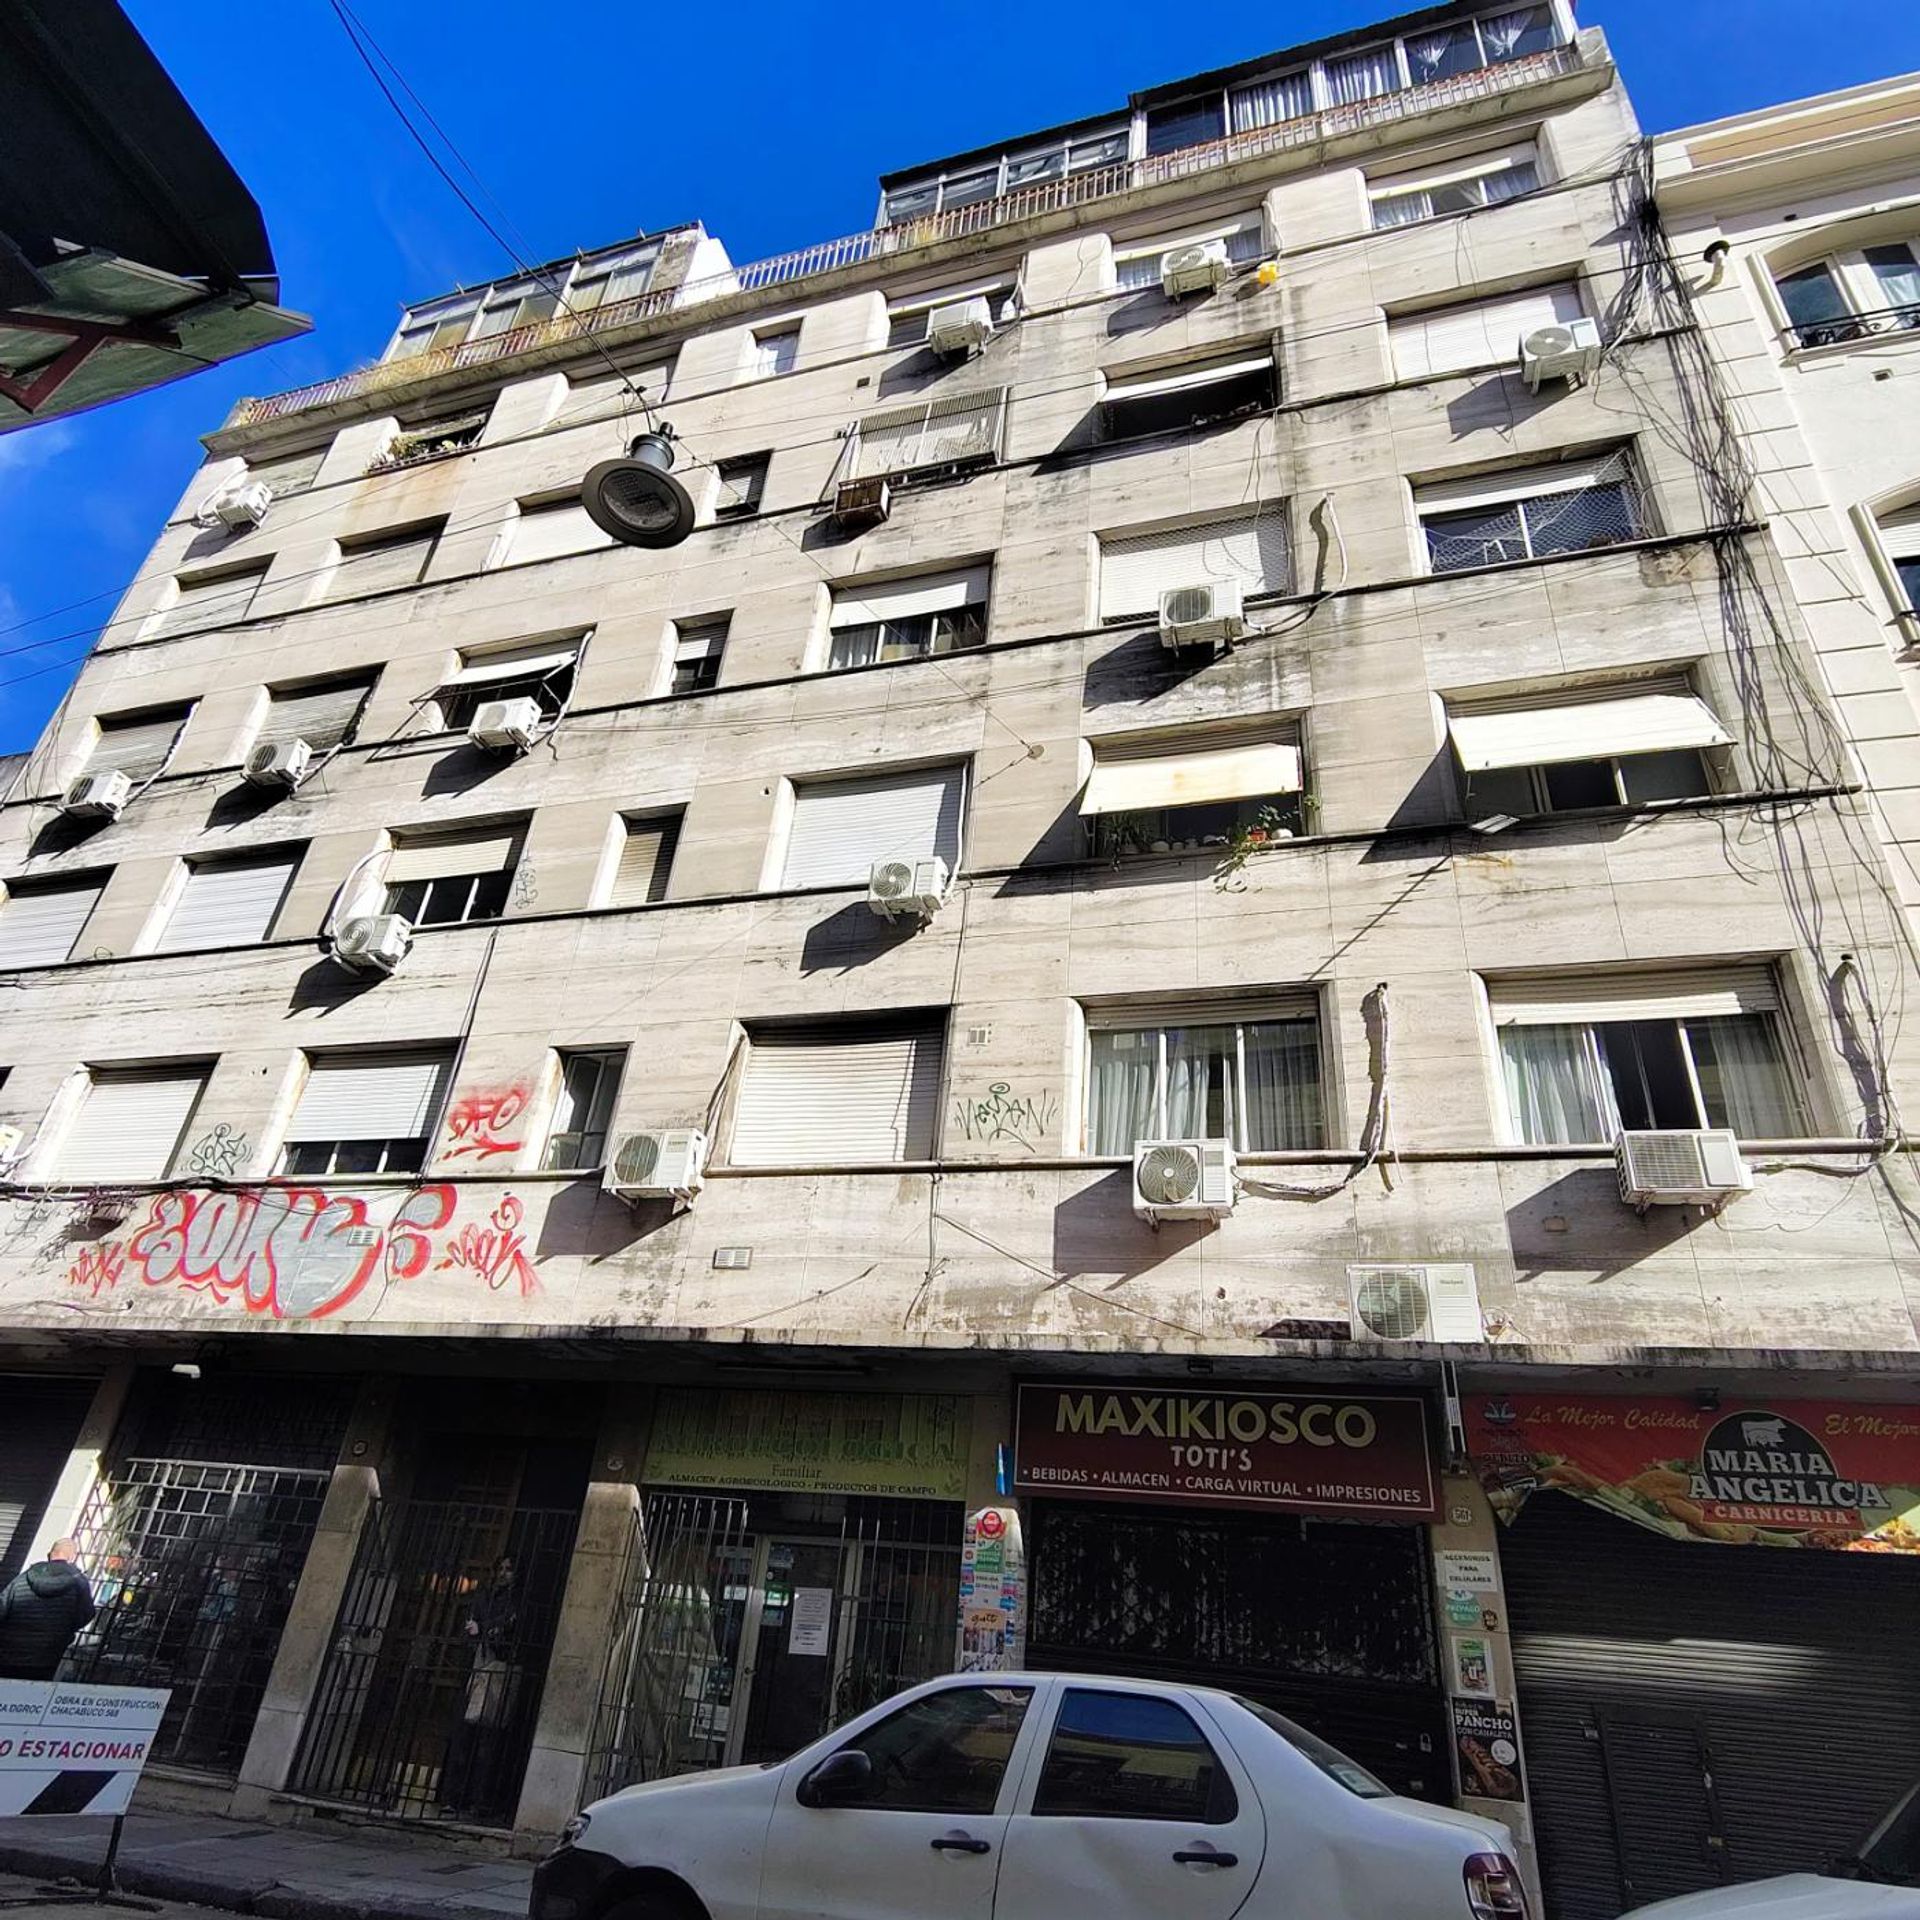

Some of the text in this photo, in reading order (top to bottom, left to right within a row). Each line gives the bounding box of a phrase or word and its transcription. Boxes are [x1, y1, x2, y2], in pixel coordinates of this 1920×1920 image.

[1055, 1394, 1377, 1448] MAXIKIOSCO
[1525, 1405, 1700, 1430] La Mejor Calidad
[1825, 1413, 1850, 1435] El
[1170, 1444, 1253, 1473] TOTI'S
[1705, 1448, 1834, 1476] MARIA
[772, 1464, 822, 1479] Familiar
[669, 1473, 716, 1484] ALMACEN
[814, 1481, 878, 1492] PRODUCTOS
[880, 1485, 896, 1494] DE
[897, 1485, 937, 1496] CAMPO
[1032, 1467, 1421, 1503] BEBIDAS ALMACEN CARGA VIRTUAL IMPRESIONES
[1689, 1473, 1890, 1509] ANGELICA
[1713, 1504, 1850, 1526] CARNICERIA
[1445, 1554, 1491, 1562] ACCESORIOS
[1449, 1575, 1492, 1583] CELULARES
[51, 1705, 105, 1717] CHACABUCO
[55, 1696, 161, 1710] OBRA EN CONSTRUCCION
[1455, 1714, 1513, 1731] PANCHO
[18, 1740, 146, 1760] ESTACIONAR
